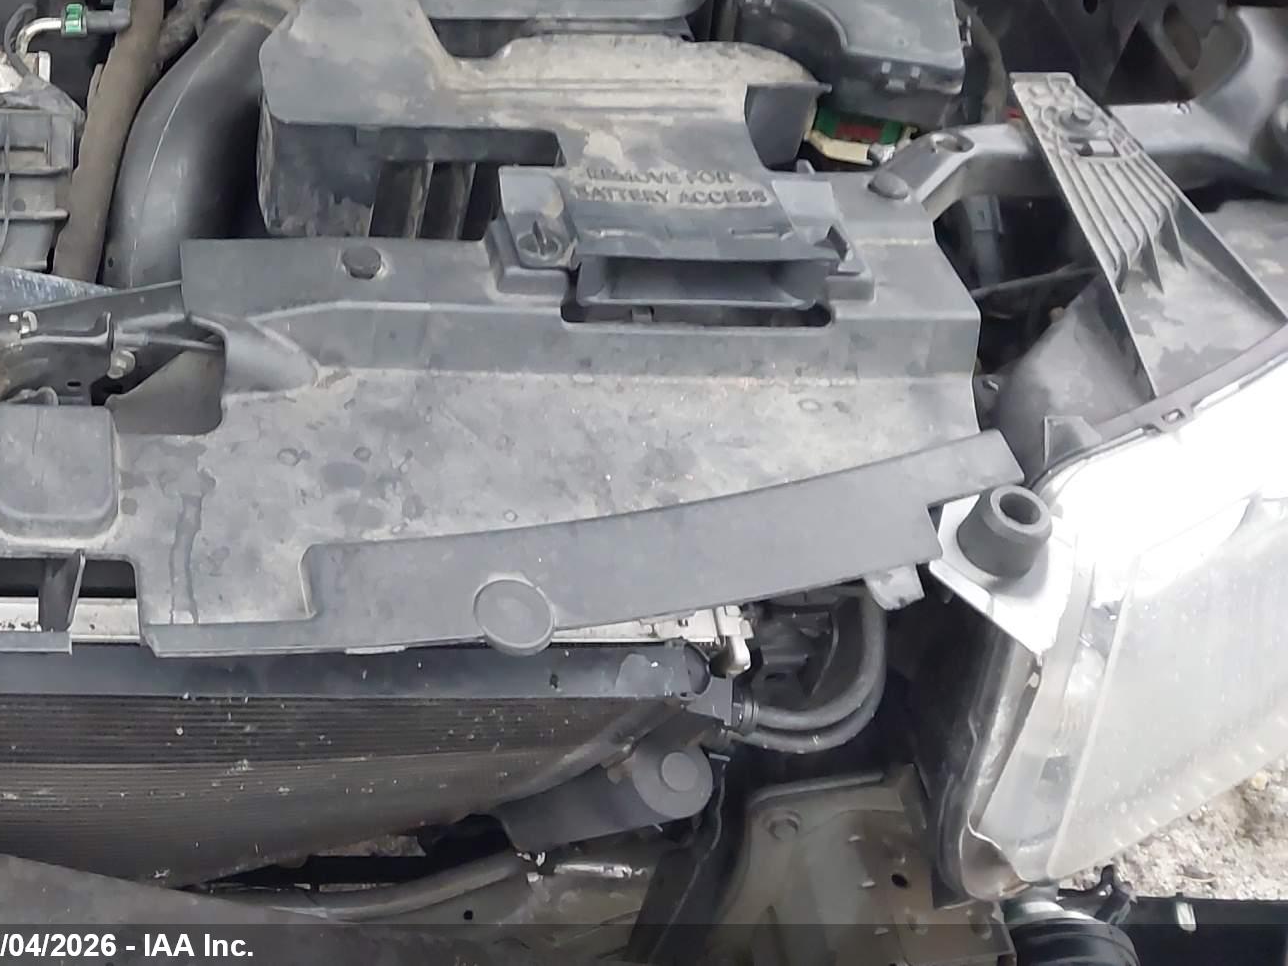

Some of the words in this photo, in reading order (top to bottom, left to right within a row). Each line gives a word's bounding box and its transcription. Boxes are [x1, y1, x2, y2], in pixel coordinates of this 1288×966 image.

[587, 168, 682, 184] REMOVE
[686, 170, 733, 185] FOR
[574, 187, 669, 205] BATTERY
[678, 188, 768, 205] ACCESS
